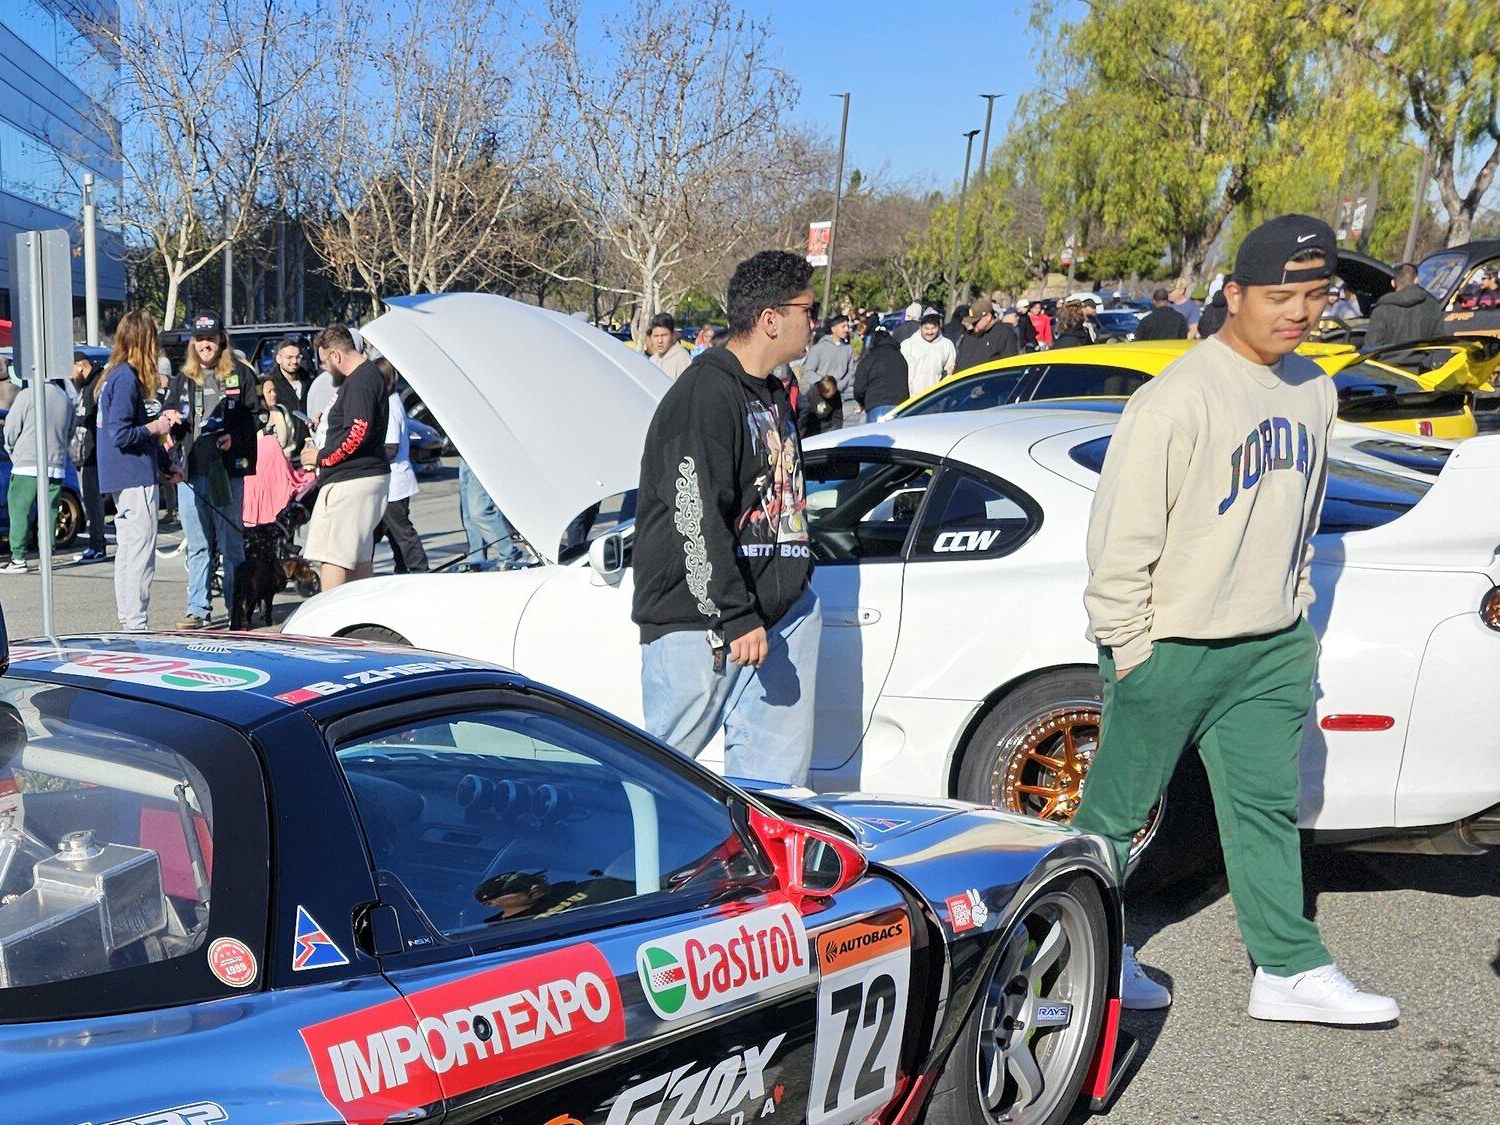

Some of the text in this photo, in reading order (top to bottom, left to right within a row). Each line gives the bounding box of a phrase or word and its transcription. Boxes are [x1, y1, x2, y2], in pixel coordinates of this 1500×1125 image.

[1218, 416, 1317, 515] JORDA
[737, 543, 779, 558] BETT
[932, 529, 1002, 553] CCW
[838, 923, 904, 955] AUTOBACS
[683, 911, 804, 1003] Castrol
[1038, 1007, 1067, 1017] RAYS
[822, 973, 897, 1114] 72
